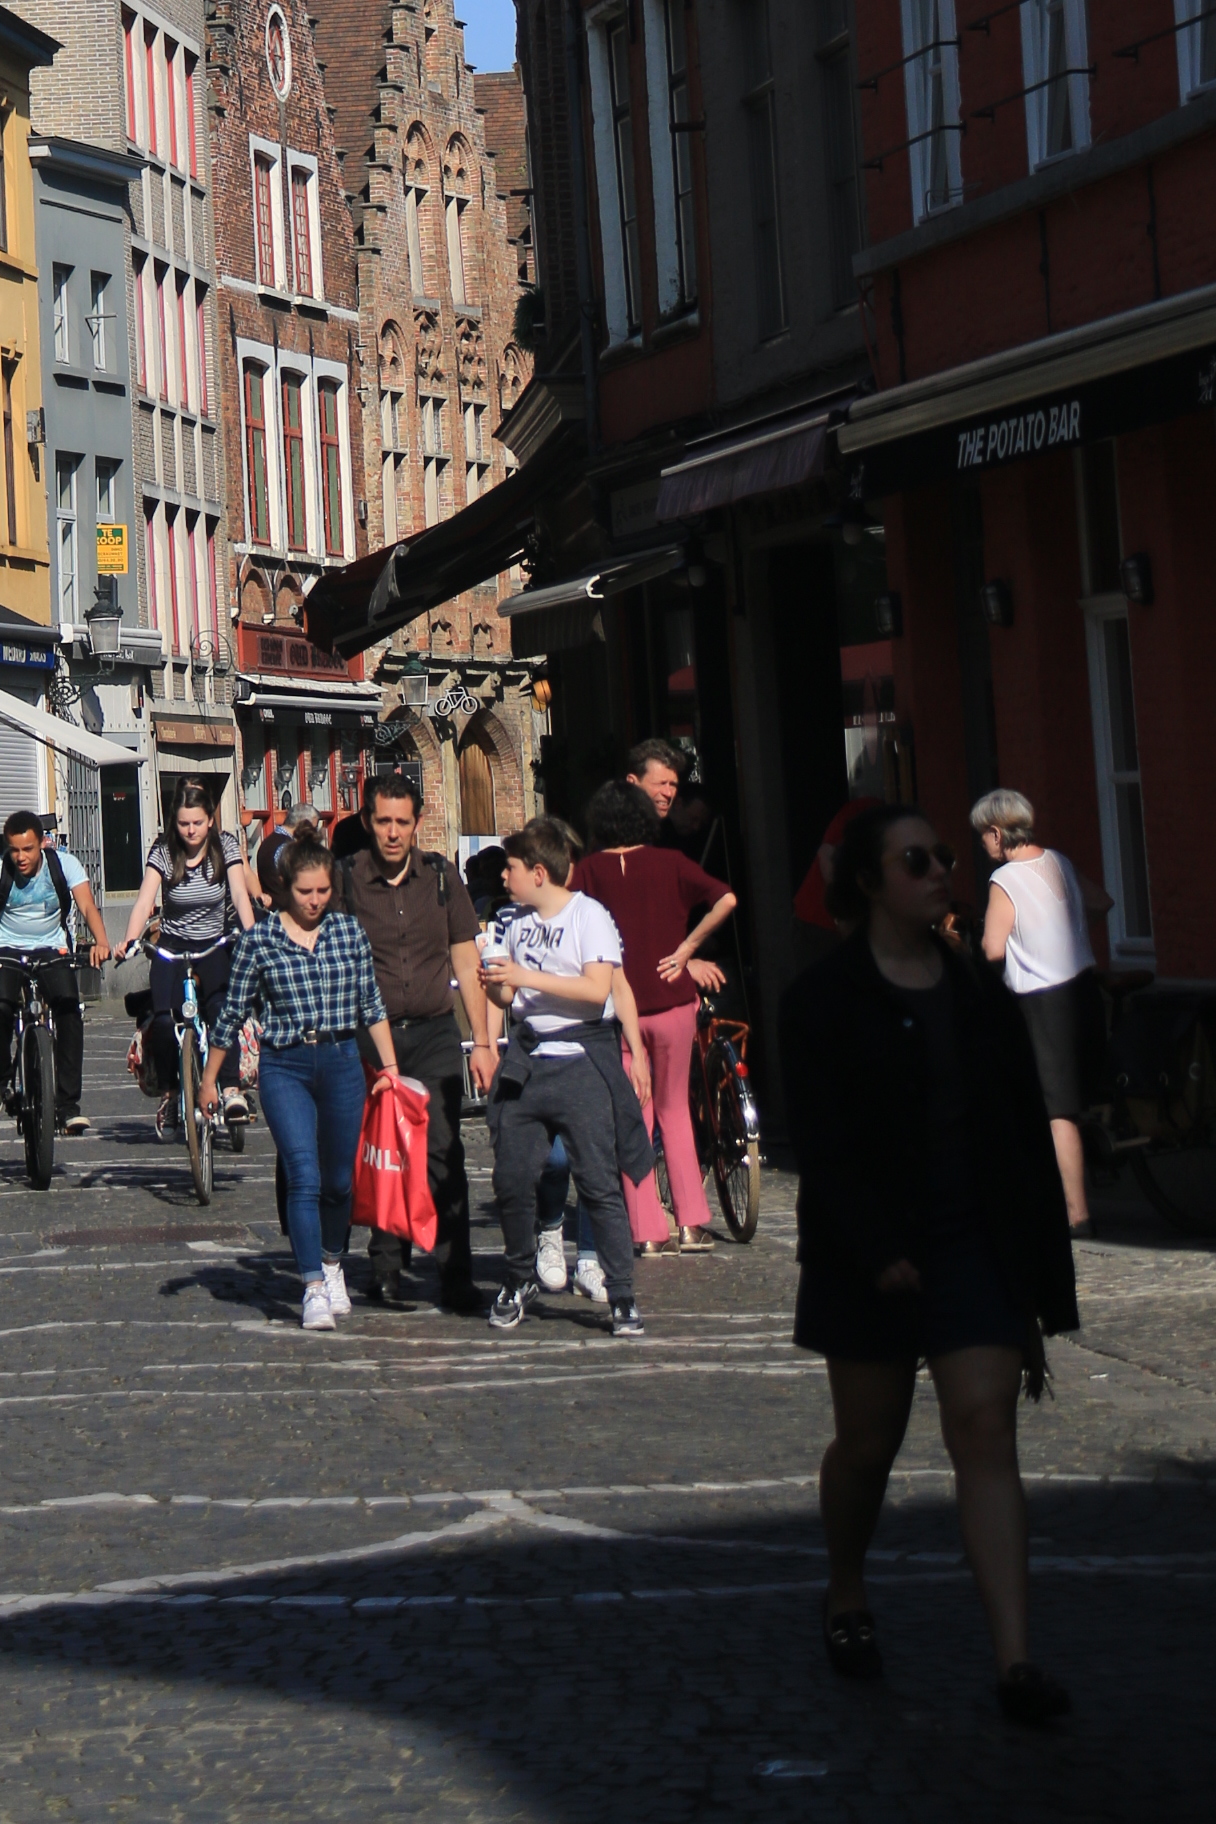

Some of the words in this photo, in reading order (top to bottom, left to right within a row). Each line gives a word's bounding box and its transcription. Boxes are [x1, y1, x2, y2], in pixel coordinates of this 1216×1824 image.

[957, 427, 985, 469] THE
[986, 409, 1046, 461] POTATO
[1047, 400, 1081, 446] BAR
[101, 529, 113, 537] TE
[516, 926, 564, 948] PUMA
[362, 1140, 406, 1172] ONLY
